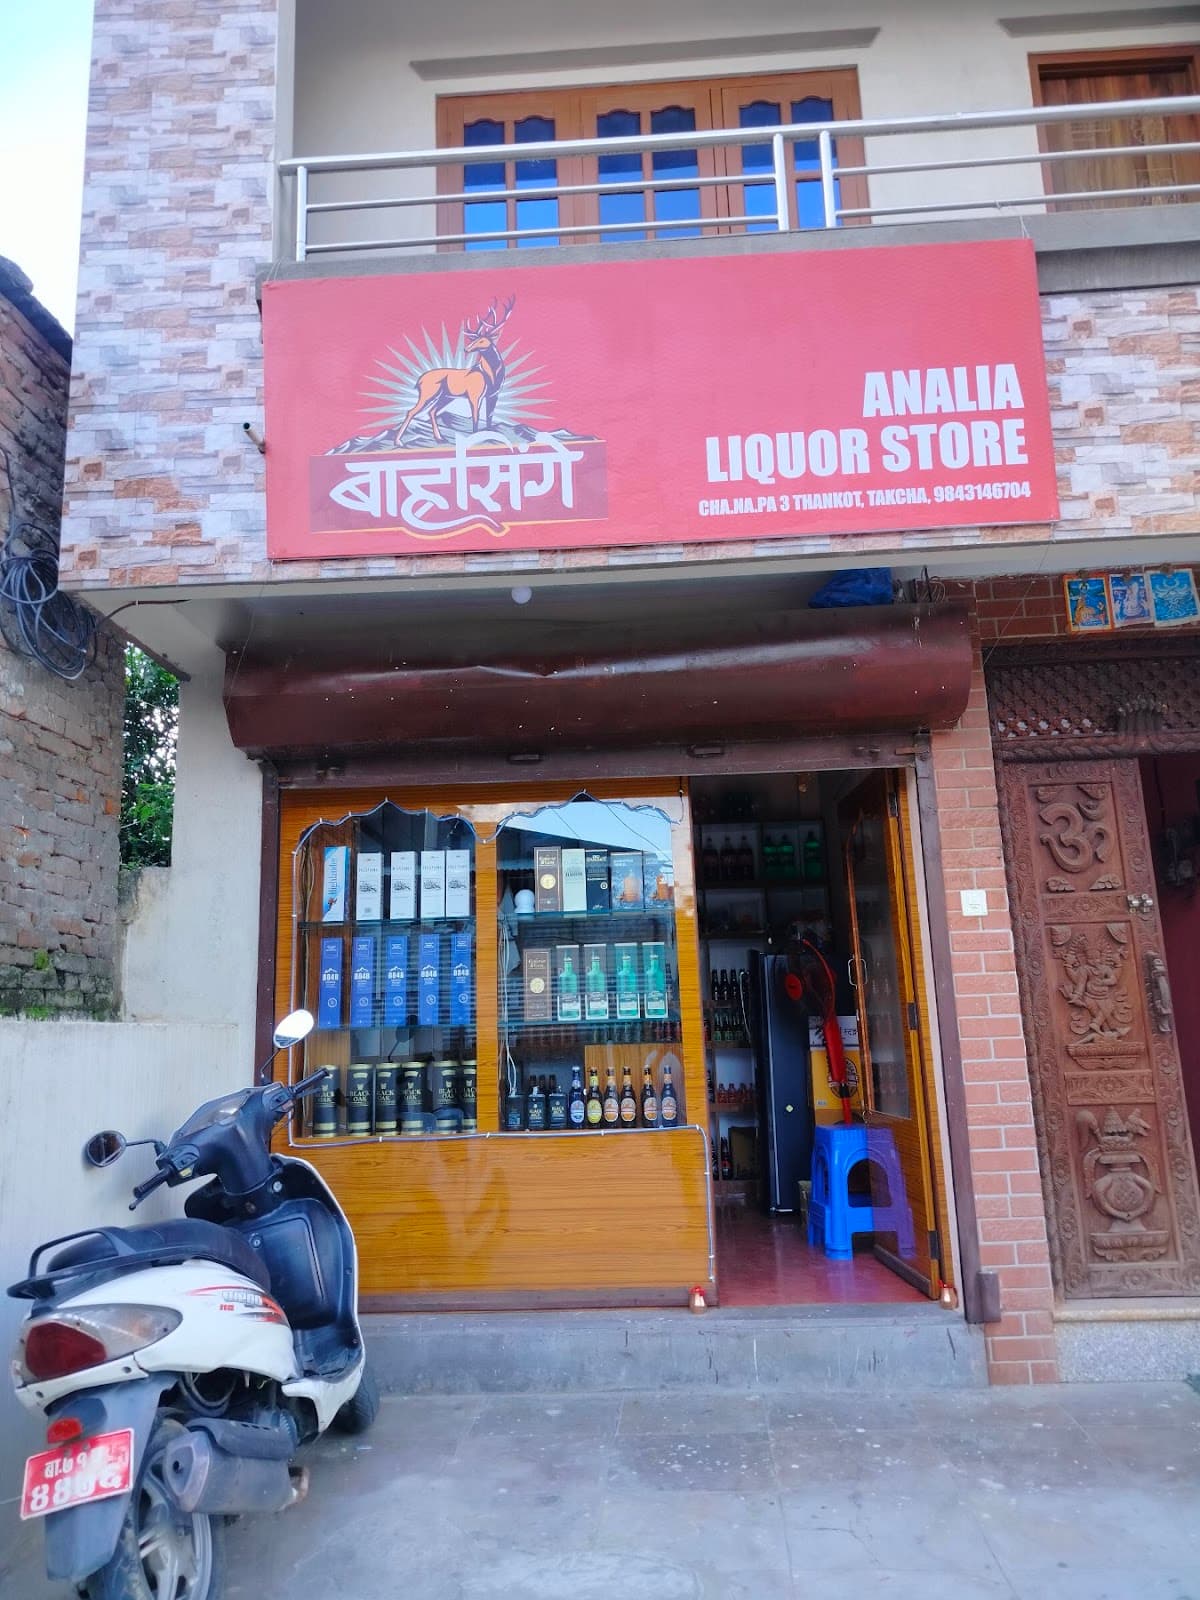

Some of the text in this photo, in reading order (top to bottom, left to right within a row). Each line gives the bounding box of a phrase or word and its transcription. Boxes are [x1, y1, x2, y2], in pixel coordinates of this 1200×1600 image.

[863, 364, 1025, 417] ANALIA
[706, 418, 1029, 484] LIQUOR STORE
[698, 481, 1031, 516] CHA.NA.PA 3 THANKOT, TAKCHA, 9843146704
